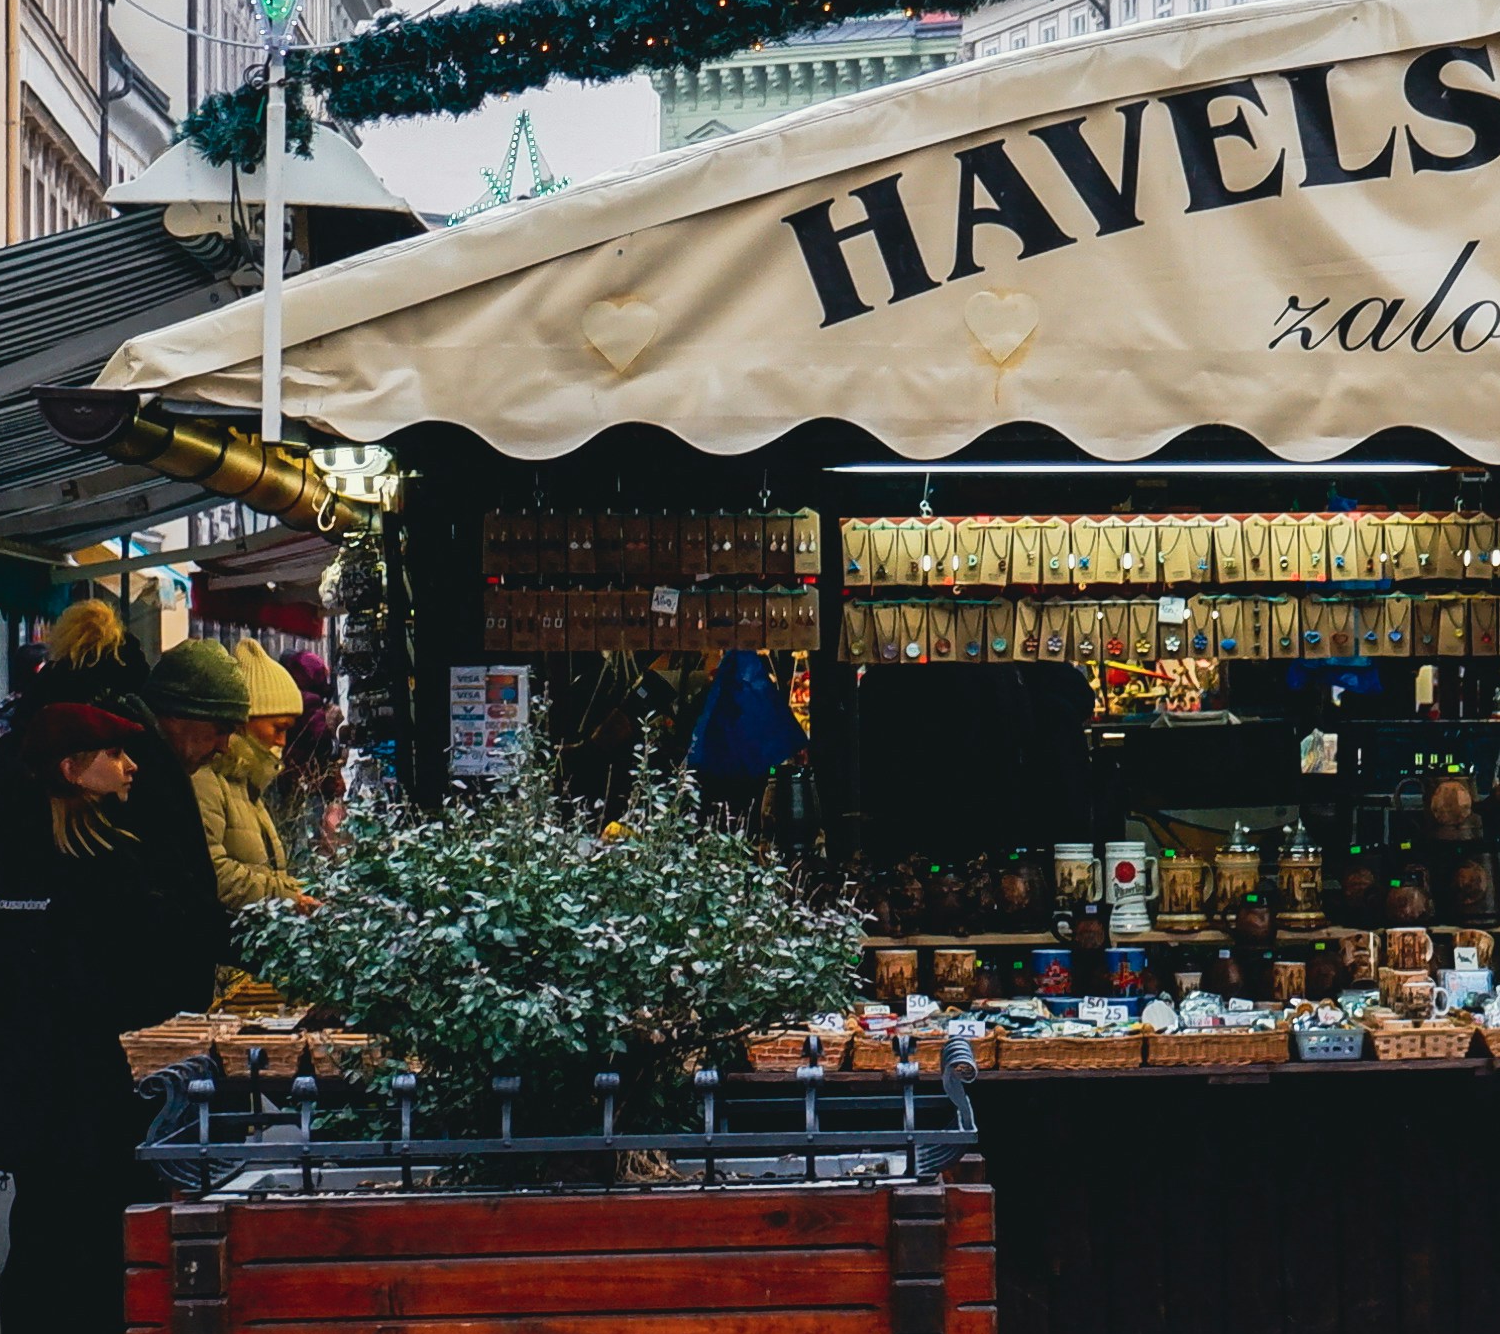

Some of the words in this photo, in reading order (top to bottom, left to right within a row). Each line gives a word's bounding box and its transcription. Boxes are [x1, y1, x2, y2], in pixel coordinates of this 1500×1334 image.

[908, 995, 927, 1008] 50
[1105, 1008, 1122, 1021] 25
[958, 1024, 976, 1036] 25
